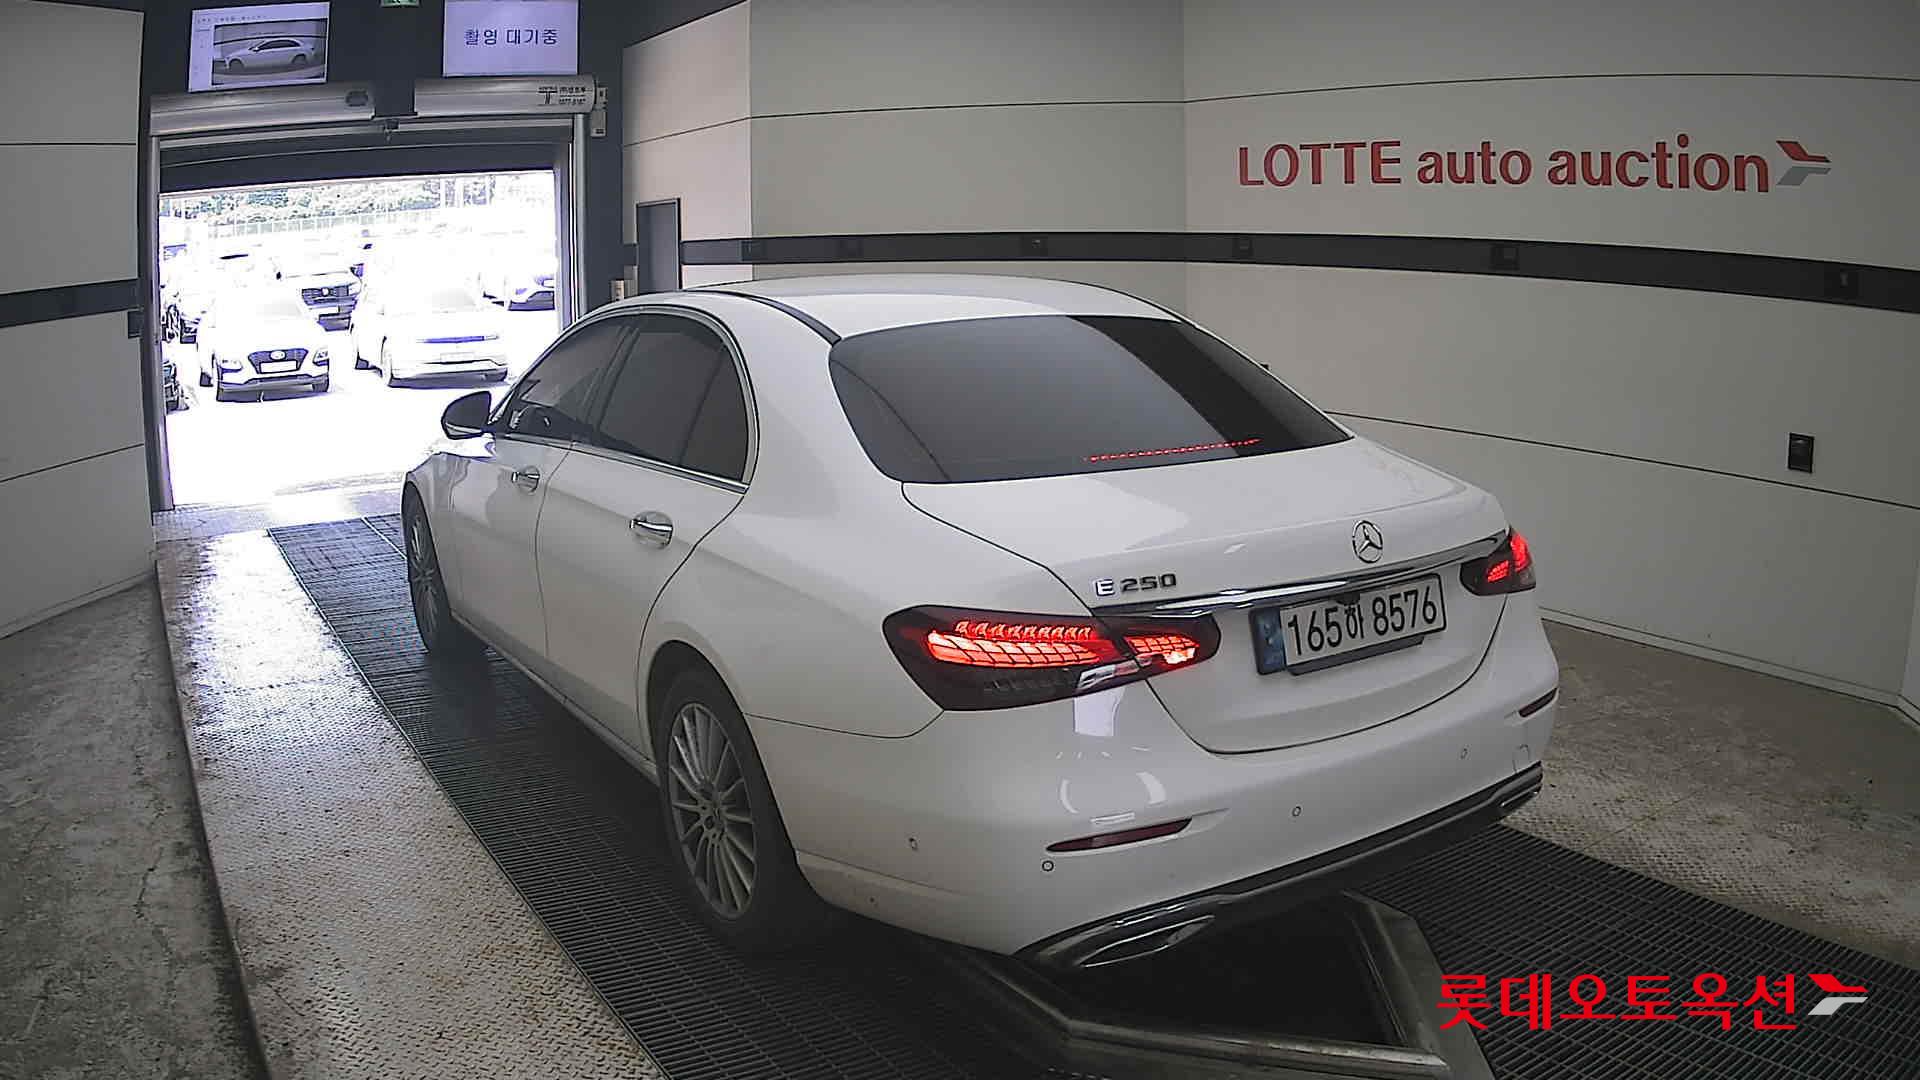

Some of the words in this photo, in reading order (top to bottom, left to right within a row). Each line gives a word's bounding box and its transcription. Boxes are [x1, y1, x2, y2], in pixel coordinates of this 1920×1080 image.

[506, 29, 558, 45] 대기중
[1239, 140, 1401, 187] LOTTE
[1417, 141, 1533, 186] auto
[1548, 134, 1770, 193] auction
[1095, 579, 1116, 597] E
[1121, 573, 1177, 593] 250
[1372, 586, 1438, 636] 8576
